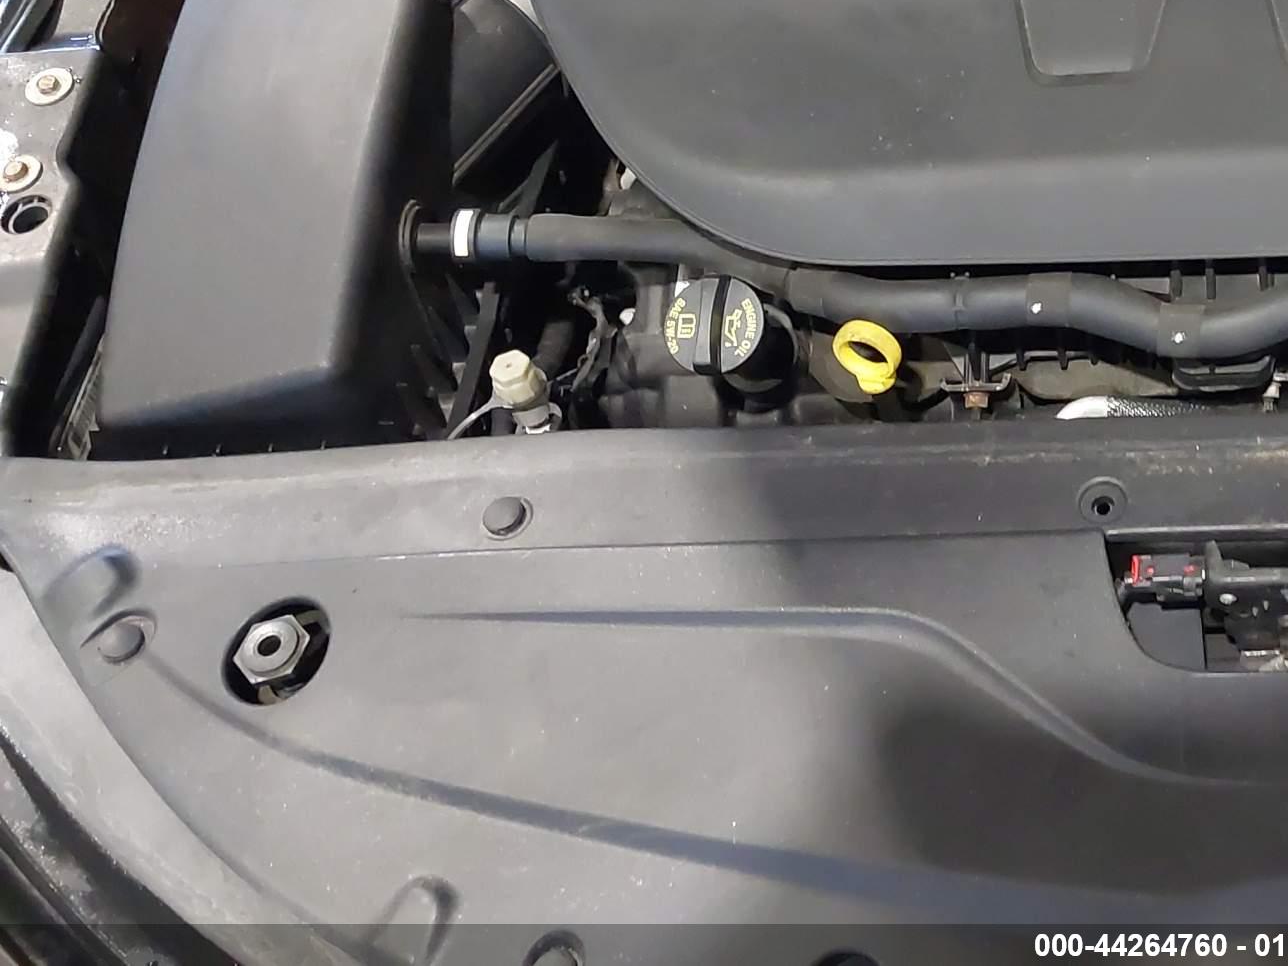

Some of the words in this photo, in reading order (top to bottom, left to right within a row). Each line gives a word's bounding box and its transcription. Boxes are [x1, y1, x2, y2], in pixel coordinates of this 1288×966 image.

[741, 298, 757, 340] ENGINE
[665, 320, 679, 355] 5W-20
[734, 339, 751, 357] OIL
